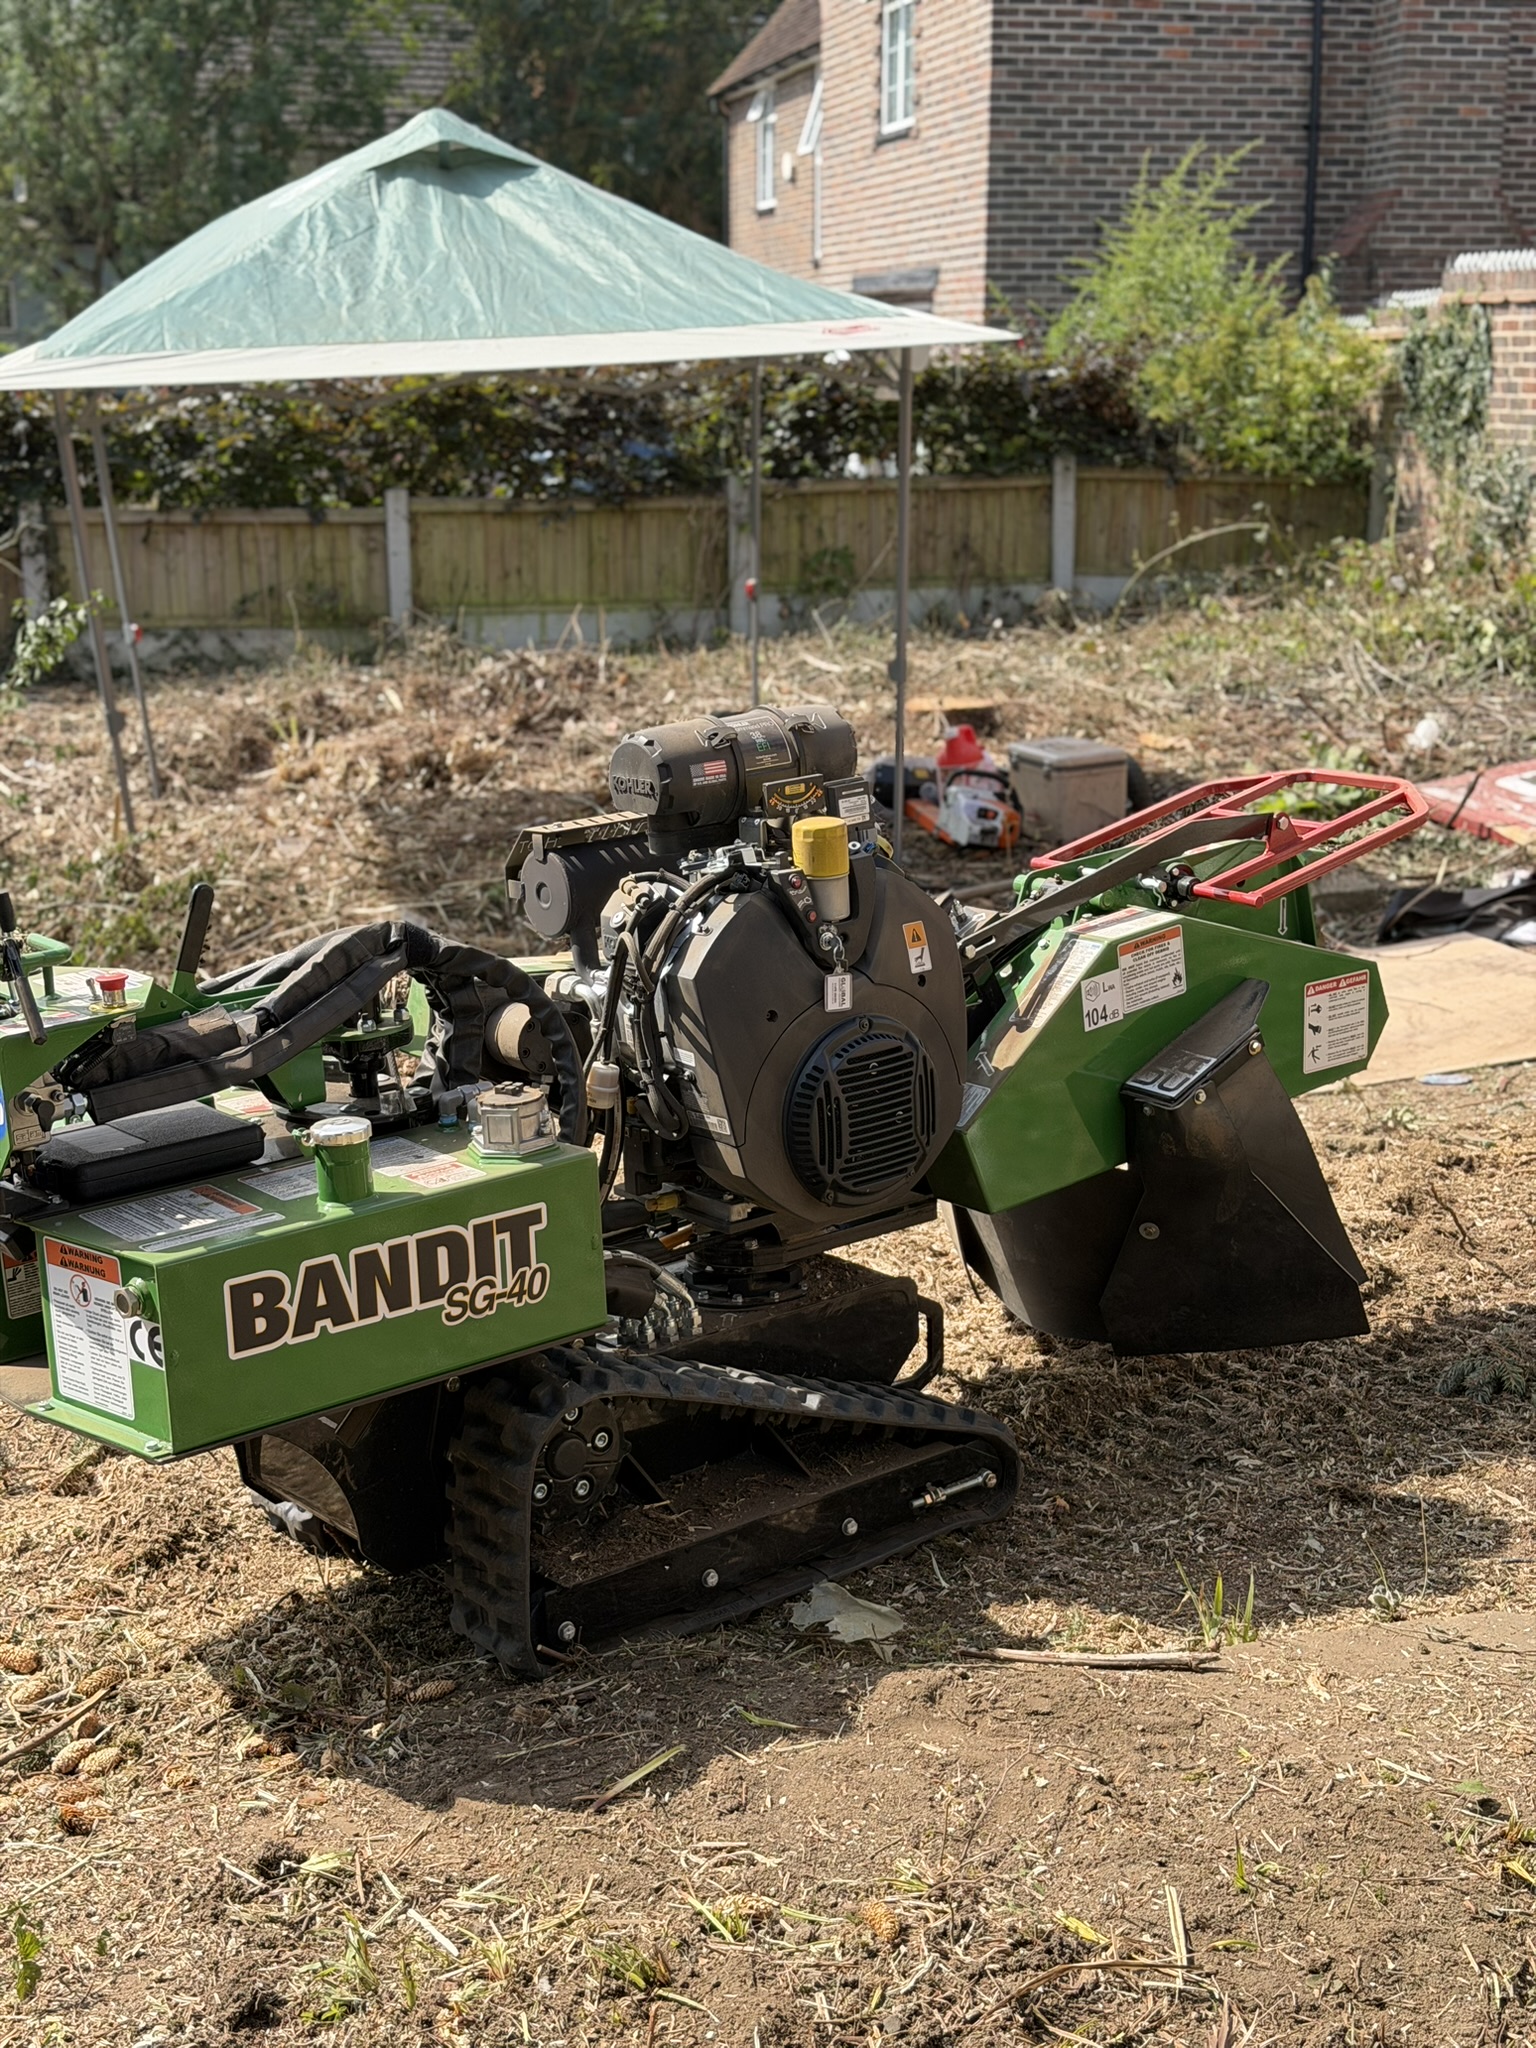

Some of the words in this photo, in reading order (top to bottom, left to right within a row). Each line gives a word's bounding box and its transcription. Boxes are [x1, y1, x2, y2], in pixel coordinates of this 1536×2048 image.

[612, 774, 658, 802] KOHLER
[1140, 934, 1166, 948] WARNING
[1315, 982, 1337, 992] DANGER
[1346, 974, 1366, 984] GEFAHR
[1085, 1004, 1109, 1028] 104
[1109, 1008, 1120, 1020] dB
[66, 1246, 104, 1265] WARNING
[66, 1258, 107, 1278] WARNUNG
[226, 1201, 547, 1358] BANDIT
[444, 1265, 548, 1322] SG-40
